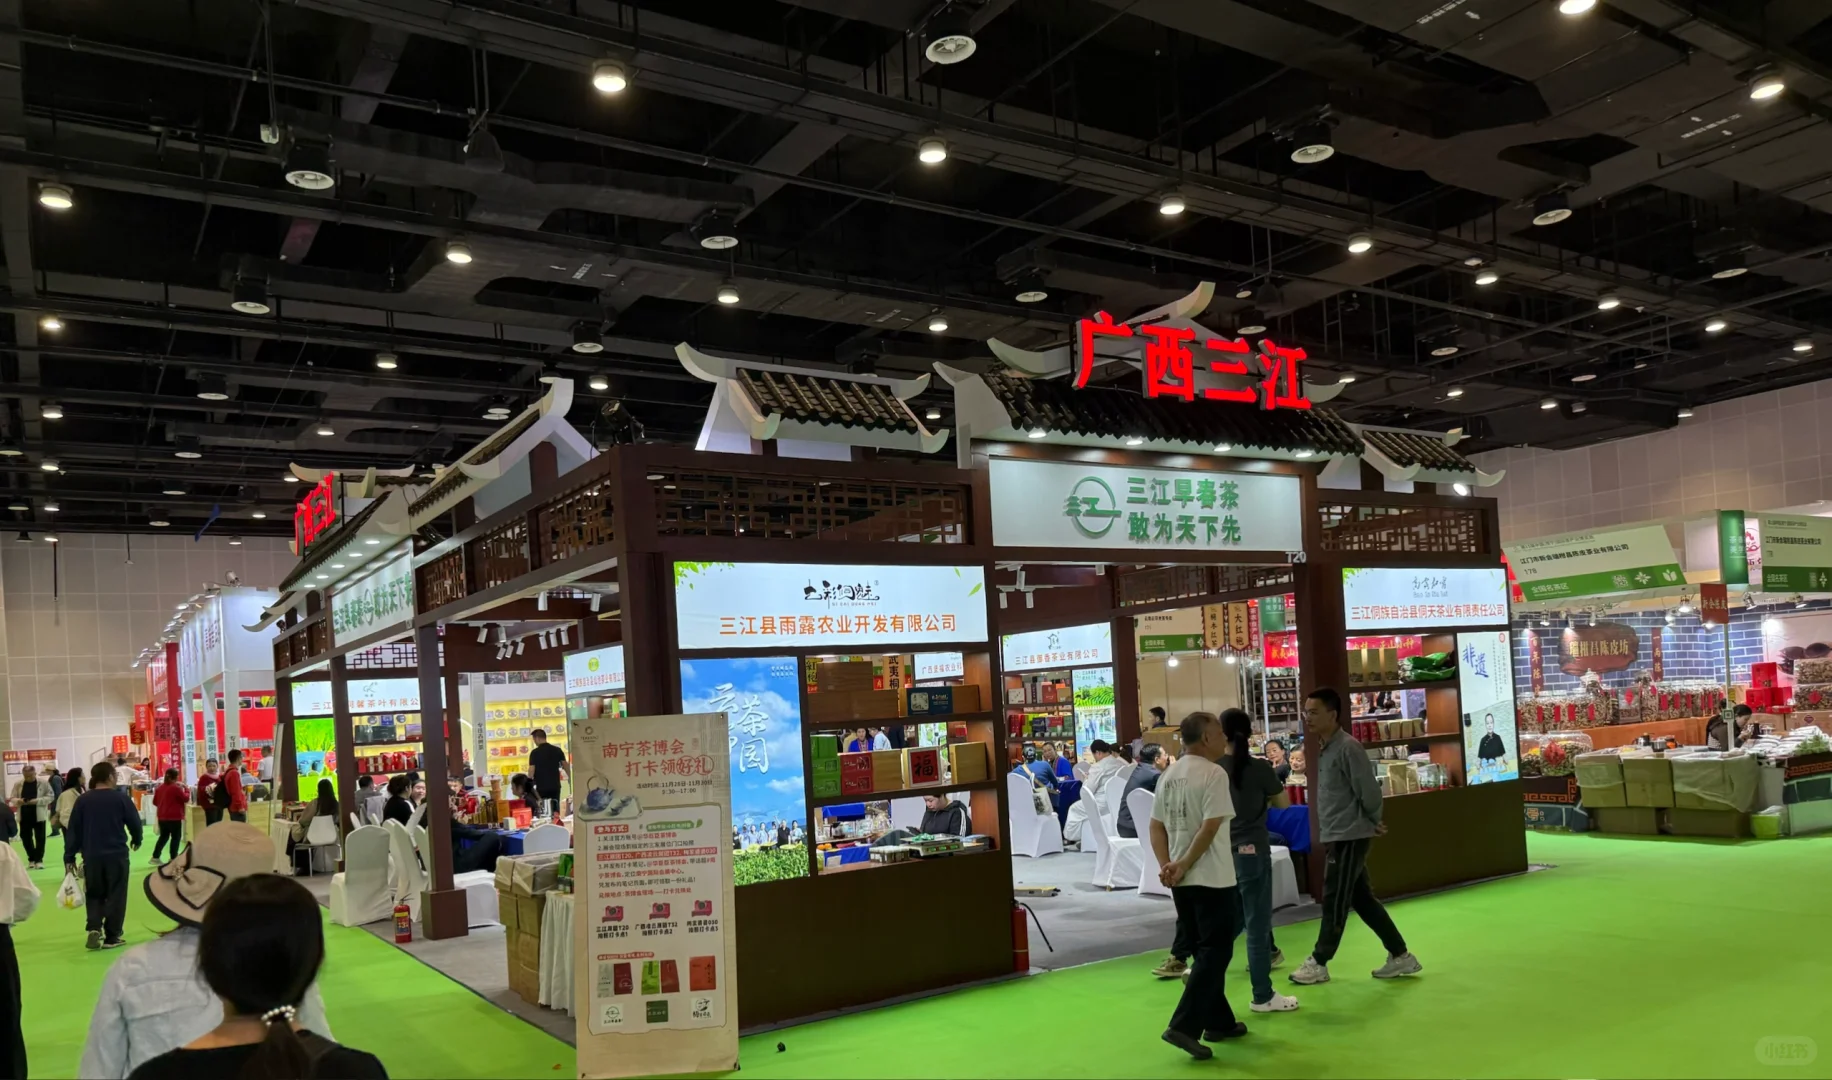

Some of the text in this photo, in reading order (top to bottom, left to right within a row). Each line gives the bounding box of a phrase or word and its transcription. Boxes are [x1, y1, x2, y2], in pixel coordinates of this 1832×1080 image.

[1076, 310, 1312, 411] 广西三江
[1127, 477, 1239, 509] 三江早春茶
[1128, 512, 1241, 544] 敢为天下先
[1286, 552, 1307, 563] T20
[1531, 582, 1570, 594] 全国名茶区
[1351, 604, 1505, 620] 三江侗族自治县侗天茶业有限责任公司
[719, 614, 956, 635] 三江县雨露农业开发有限公司
[1234, 613, 1245, 647] 大红袍
[1462, 642, 1489, 678] 非遗
[1569, 639, 1630, 658] 瑞柑昌陈皮坊
[1653, 636, 1662, 682] 一两陈
[738, 694, 770, 774] 茶园
[601, 738, 686, 759] 南宁茶博会
[625, 756, 713, 777] 打卡领好礼
[914, 754, 935, 778] 福
